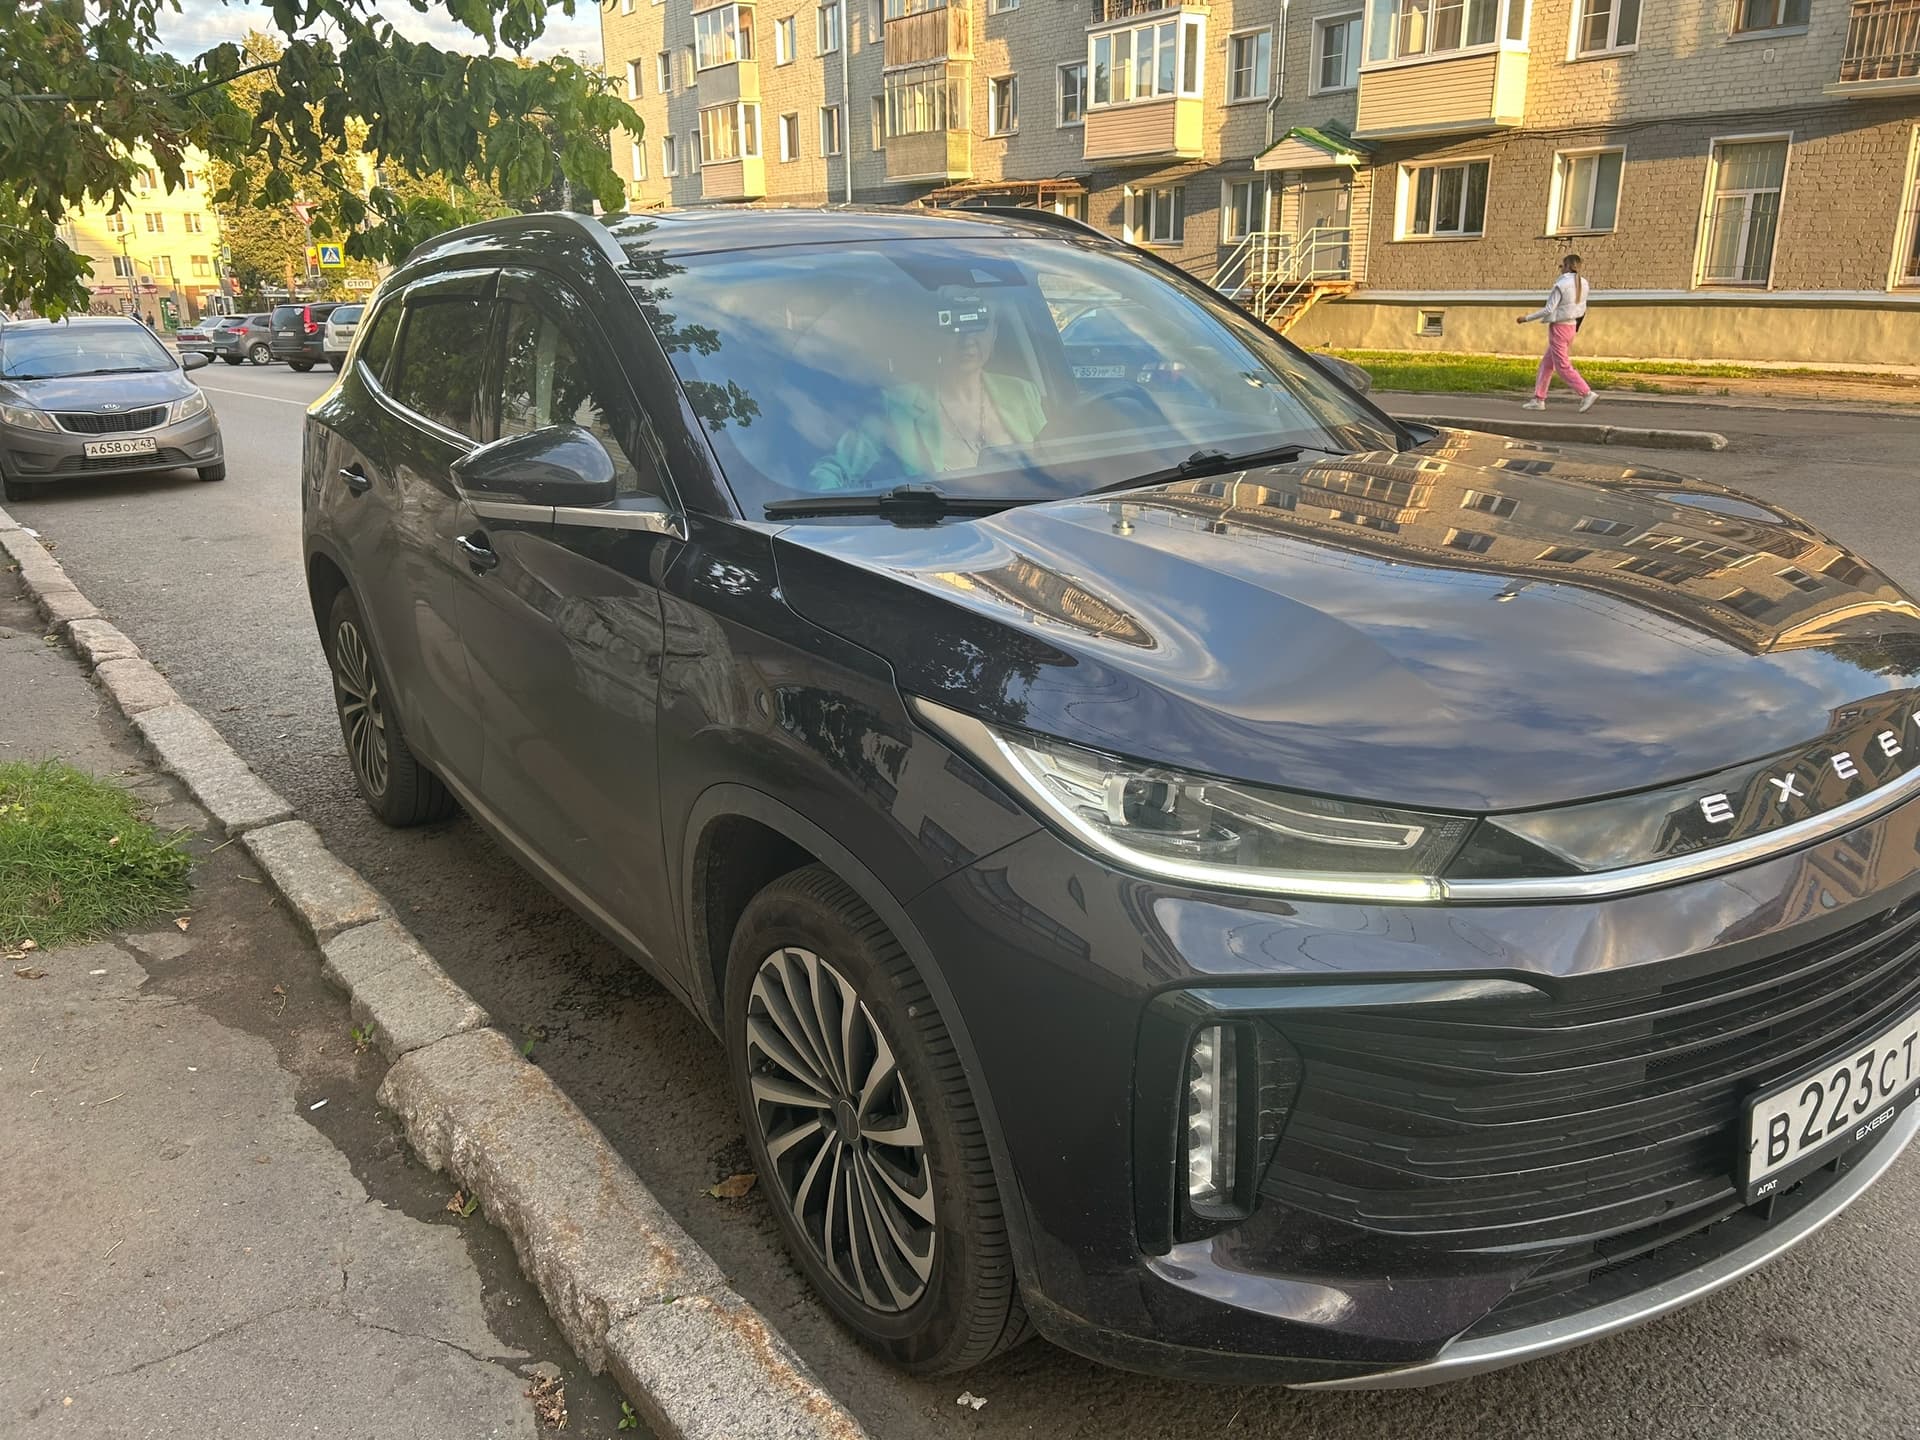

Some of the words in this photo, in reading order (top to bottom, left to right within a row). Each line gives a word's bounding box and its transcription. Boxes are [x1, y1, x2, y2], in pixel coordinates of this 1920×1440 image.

[140, 439, 152, 448] 43
[1766, 1031, 1918, 1168] В223СТ
[1855, 1106, 1895, 1141] EXEED
[1757, 1179, 1778, 1197] АГАТ
